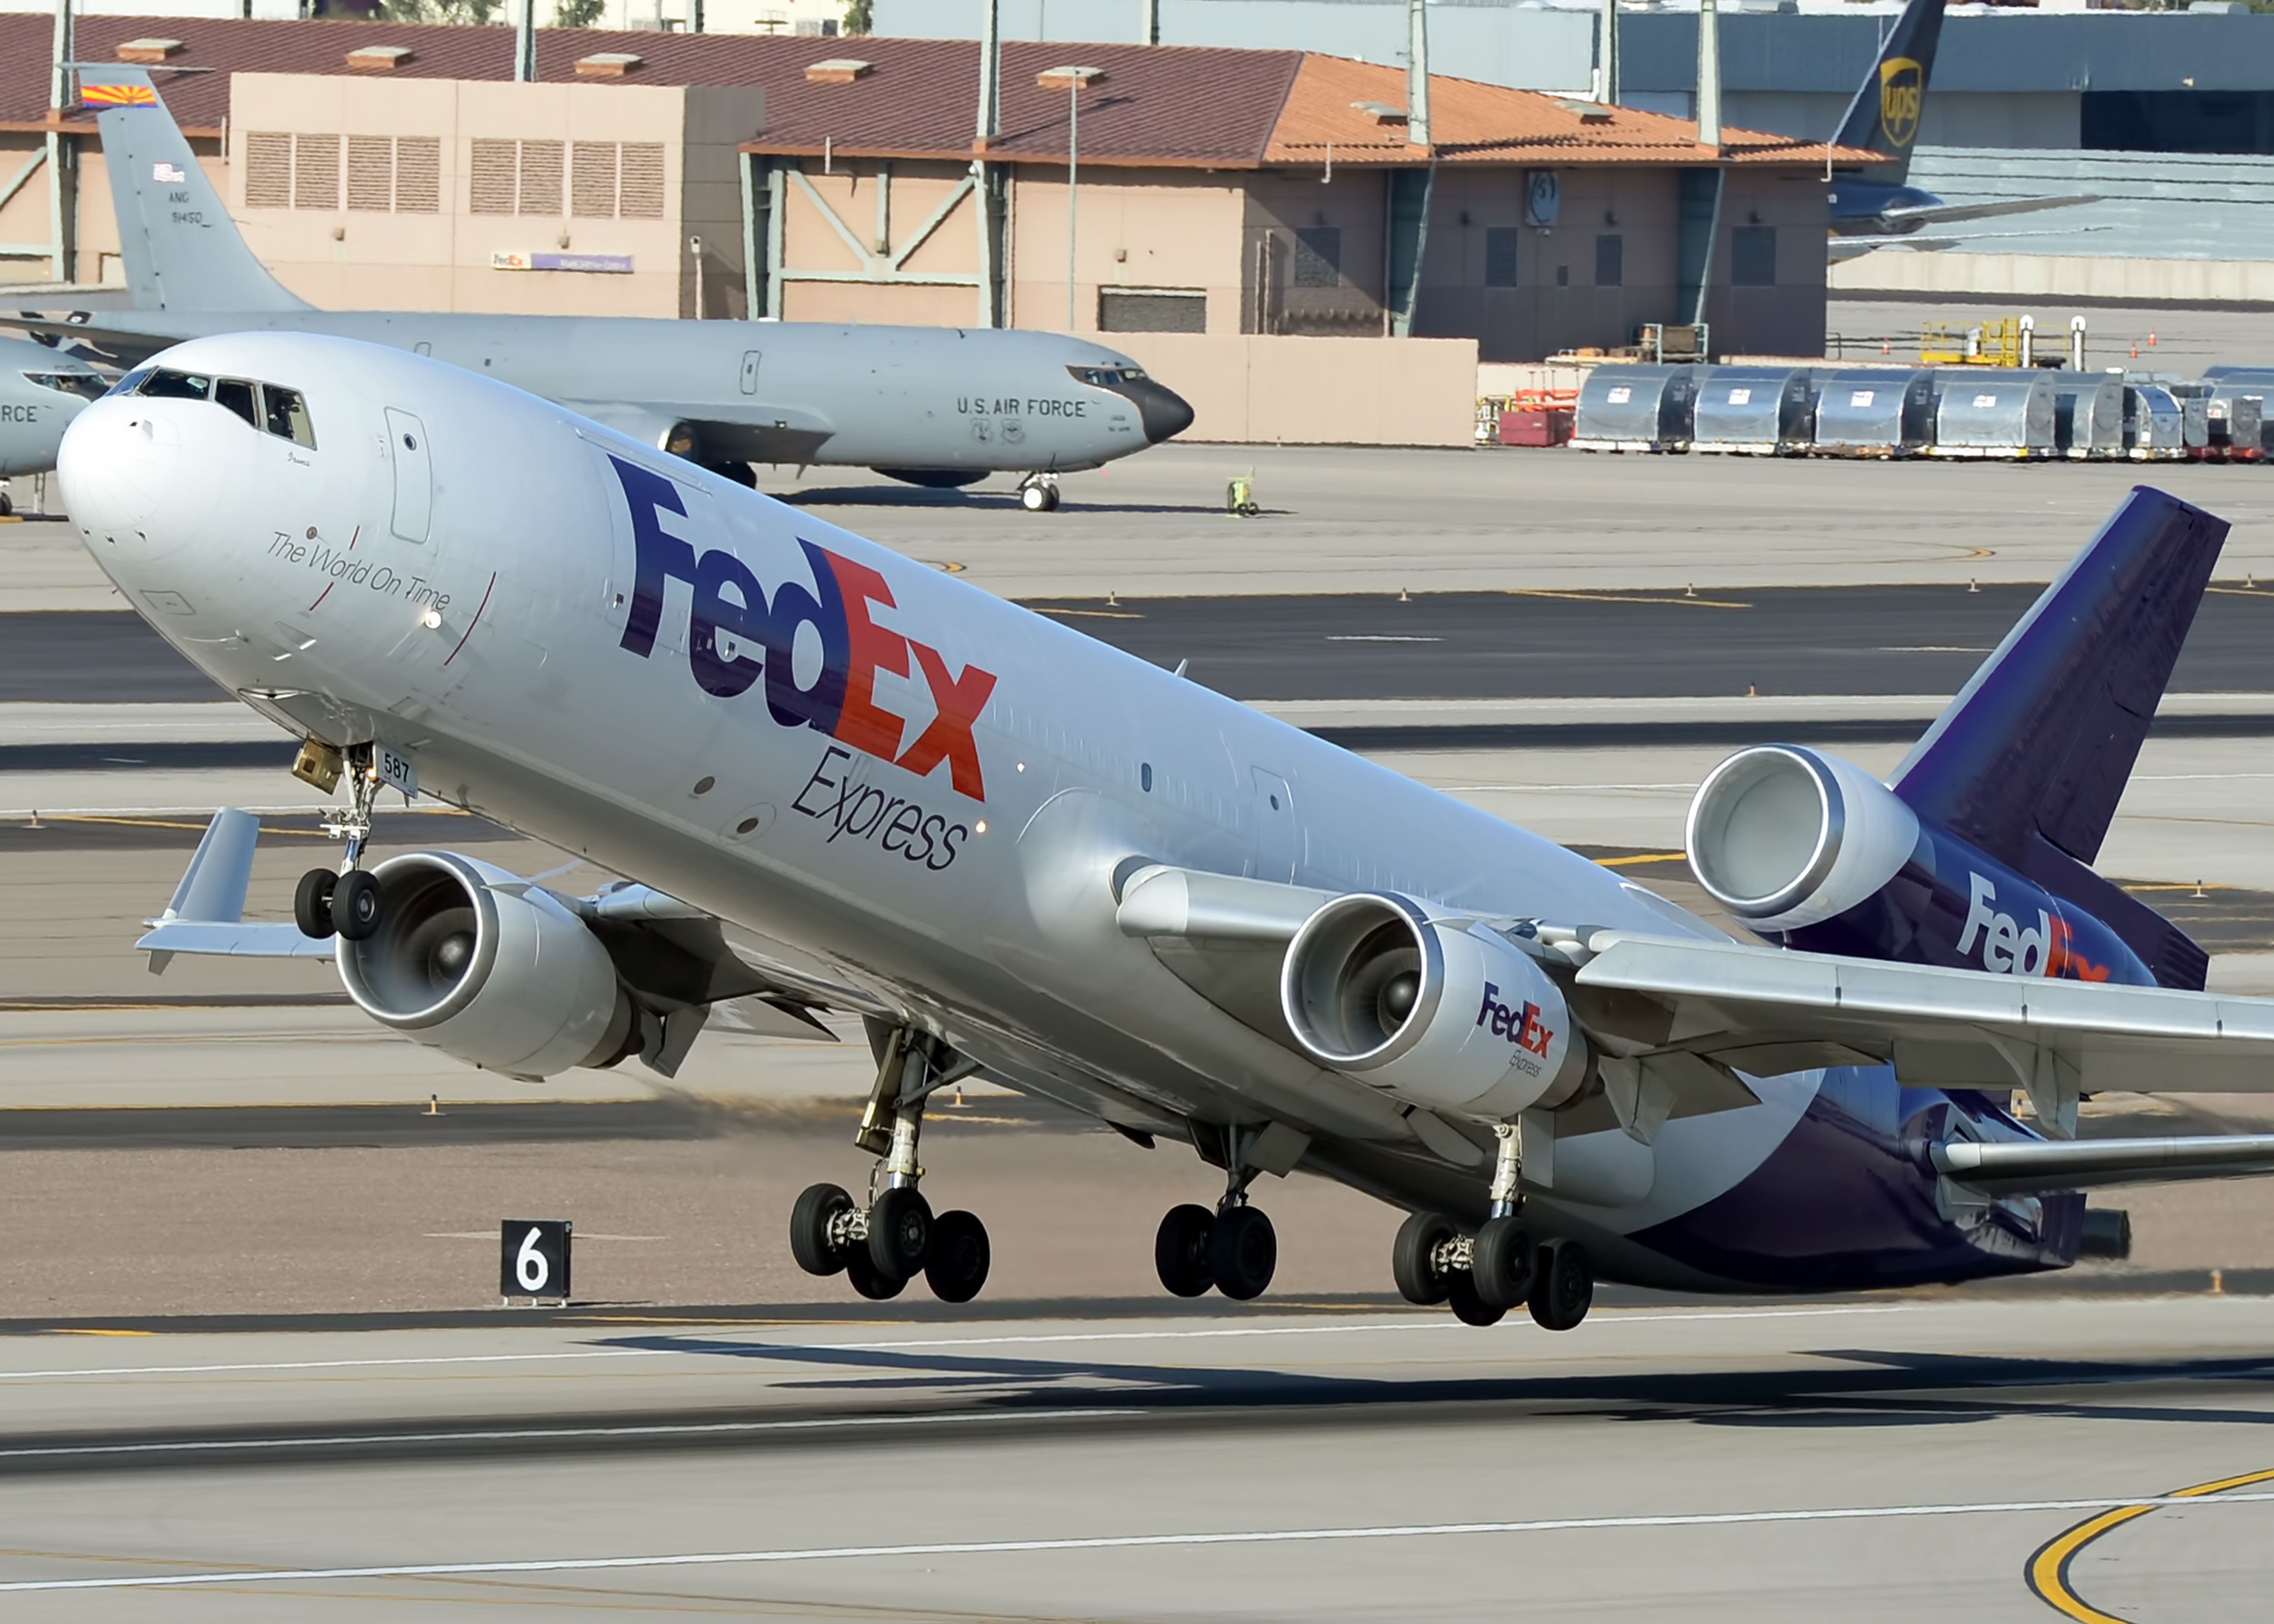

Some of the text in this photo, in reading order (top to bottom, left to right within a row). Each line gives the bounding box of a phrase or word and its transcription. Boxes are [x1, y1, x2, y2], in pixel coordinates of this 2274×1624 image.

[1887, 86, 1917, 133] ups
[993, 398, 1020, 415] AIR
[1027, 399, 1086, 417] FORCE
[267, 531, 450, 610] The World On Time
[606, 453, 997, 803] FedEx
[384, 752, 409, 783] 587
[790, 745, 968, 870] Express
[1476, 980, 1554, 1060] FedEx
[1509, 1049, 1541, 1078] Express
[516, 1226, 548, 1292] 6
